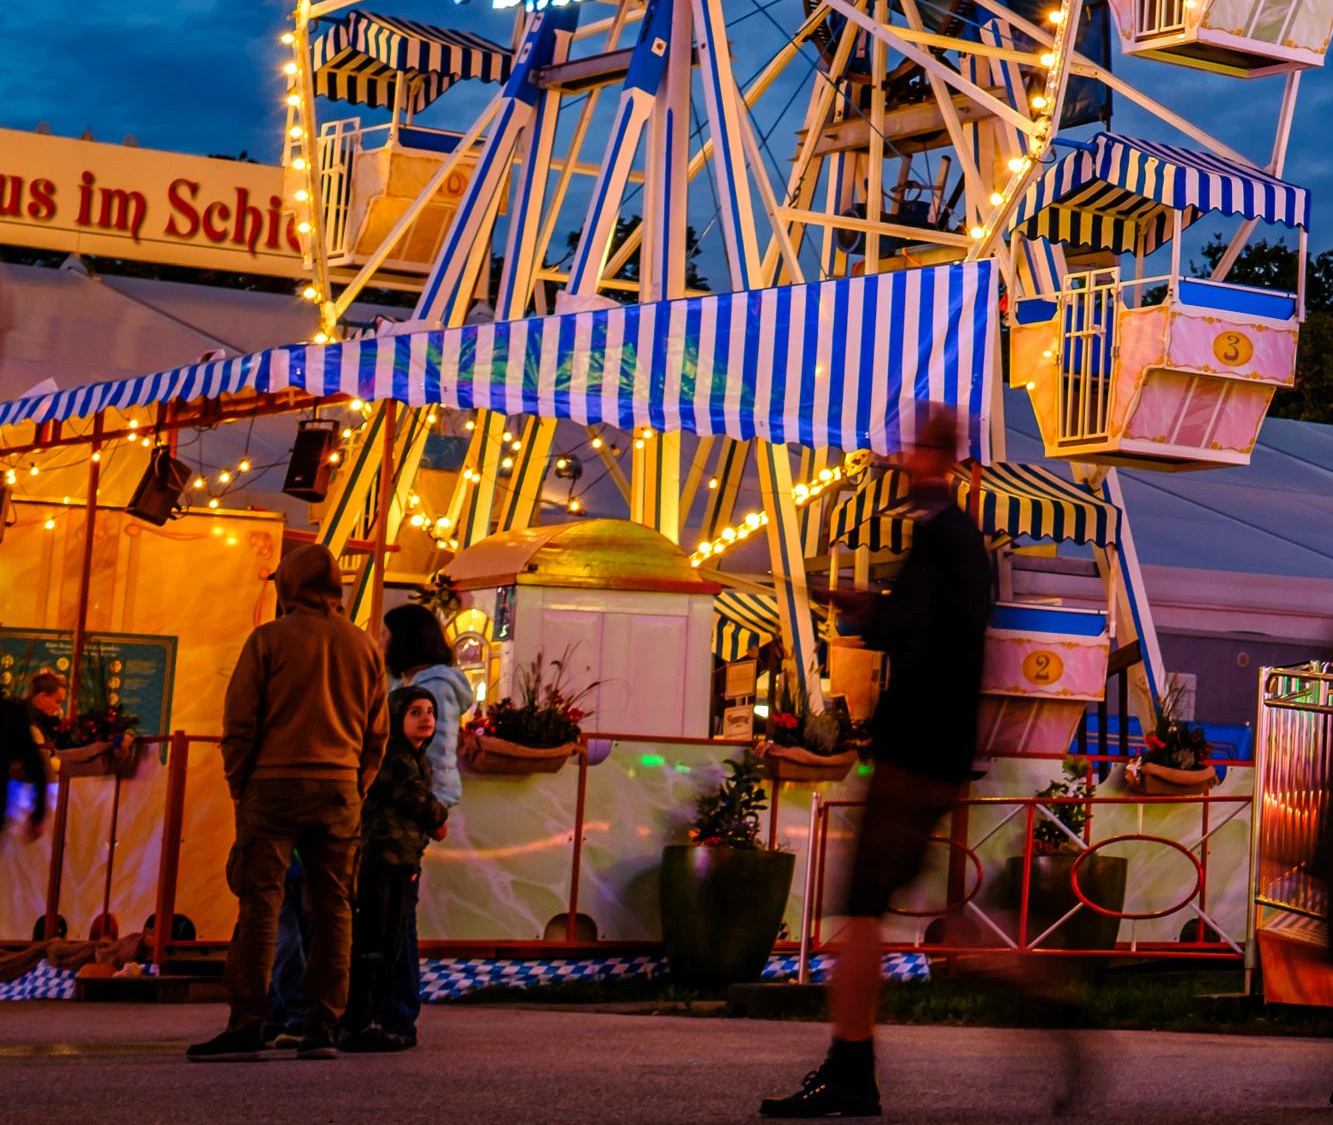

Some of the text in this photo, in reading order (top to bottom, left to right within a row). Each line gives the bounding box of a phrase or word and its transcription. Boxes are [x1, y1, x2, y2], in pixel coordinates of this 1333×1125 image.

[75, 170, 147, 244] im
[1223, 335, 1240, 362] 3
[1034, 654, 1051, 681] 2
